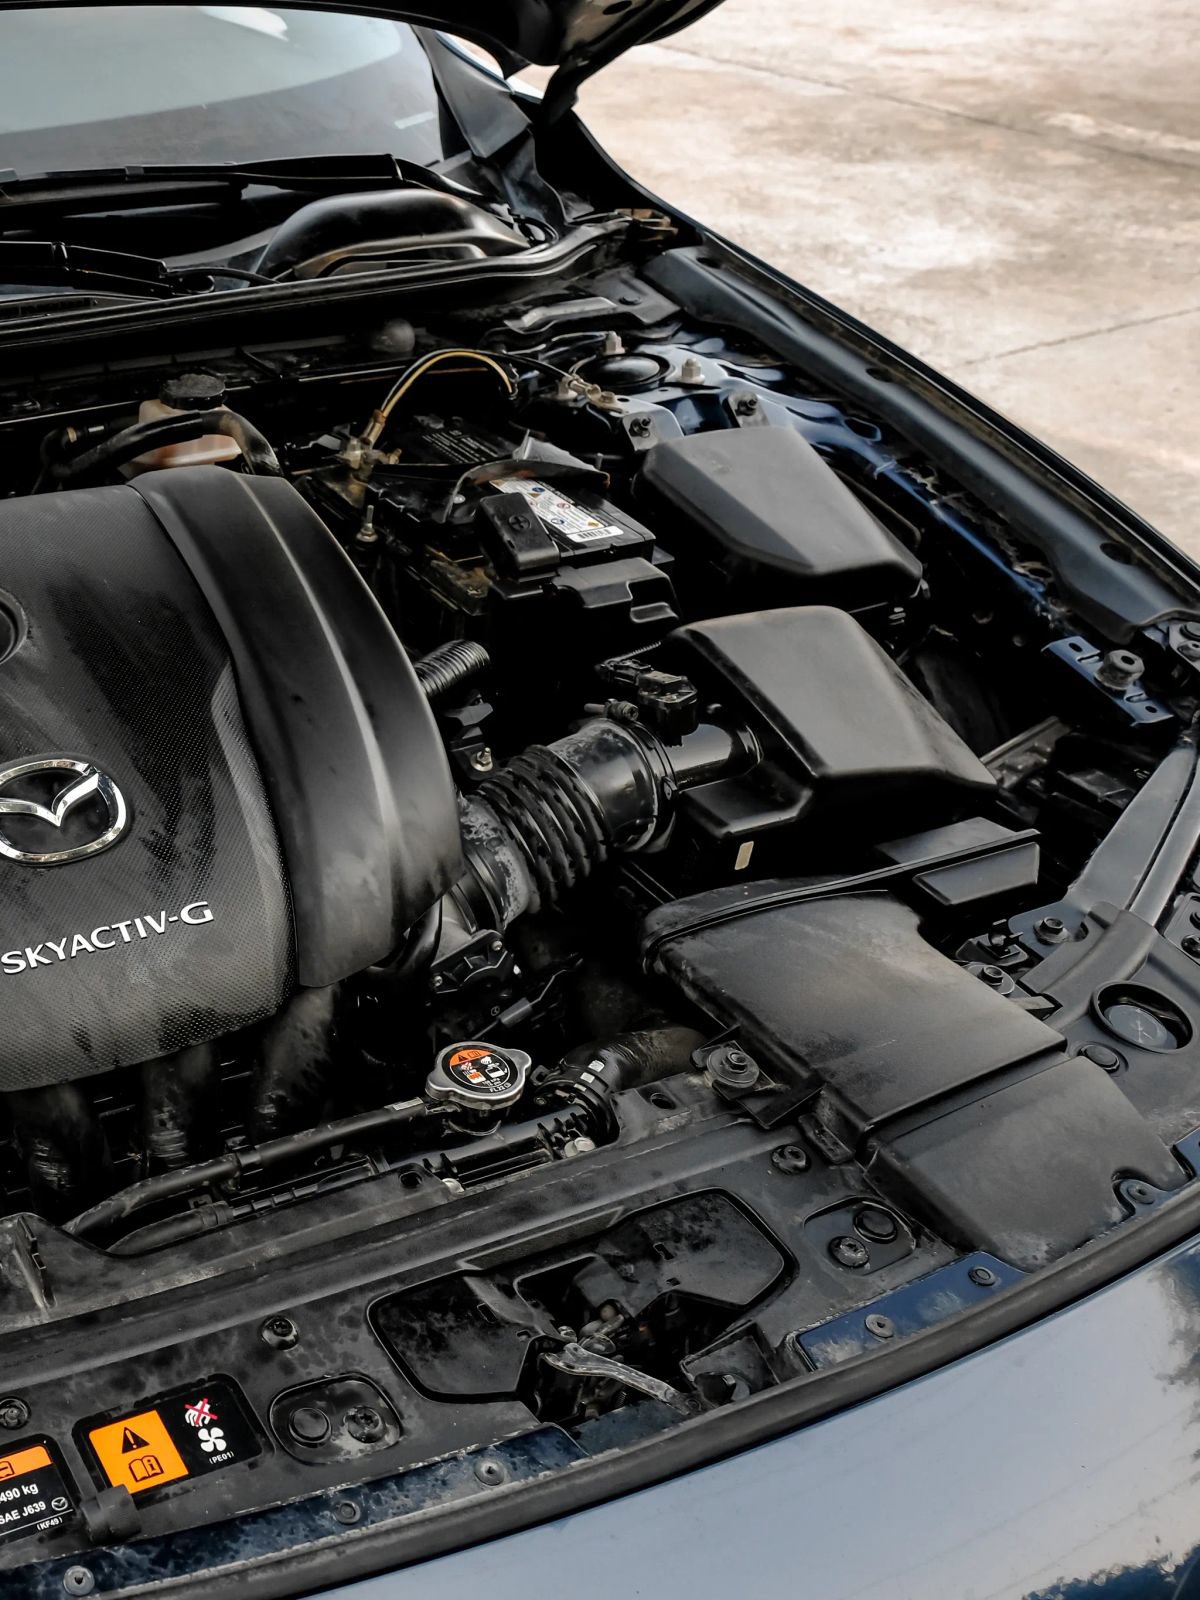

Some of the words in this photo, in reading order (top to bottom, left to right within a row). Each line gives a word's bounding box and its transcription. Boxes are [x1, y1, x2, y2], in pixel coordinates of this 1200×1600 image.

[0, 901, 215, 975] SKYACTIV-G
[21, 1483, 39, 1497] kg
[22, 1500, 47, 1517] J639
[36, 1517, 64, 1531] (KF49)
